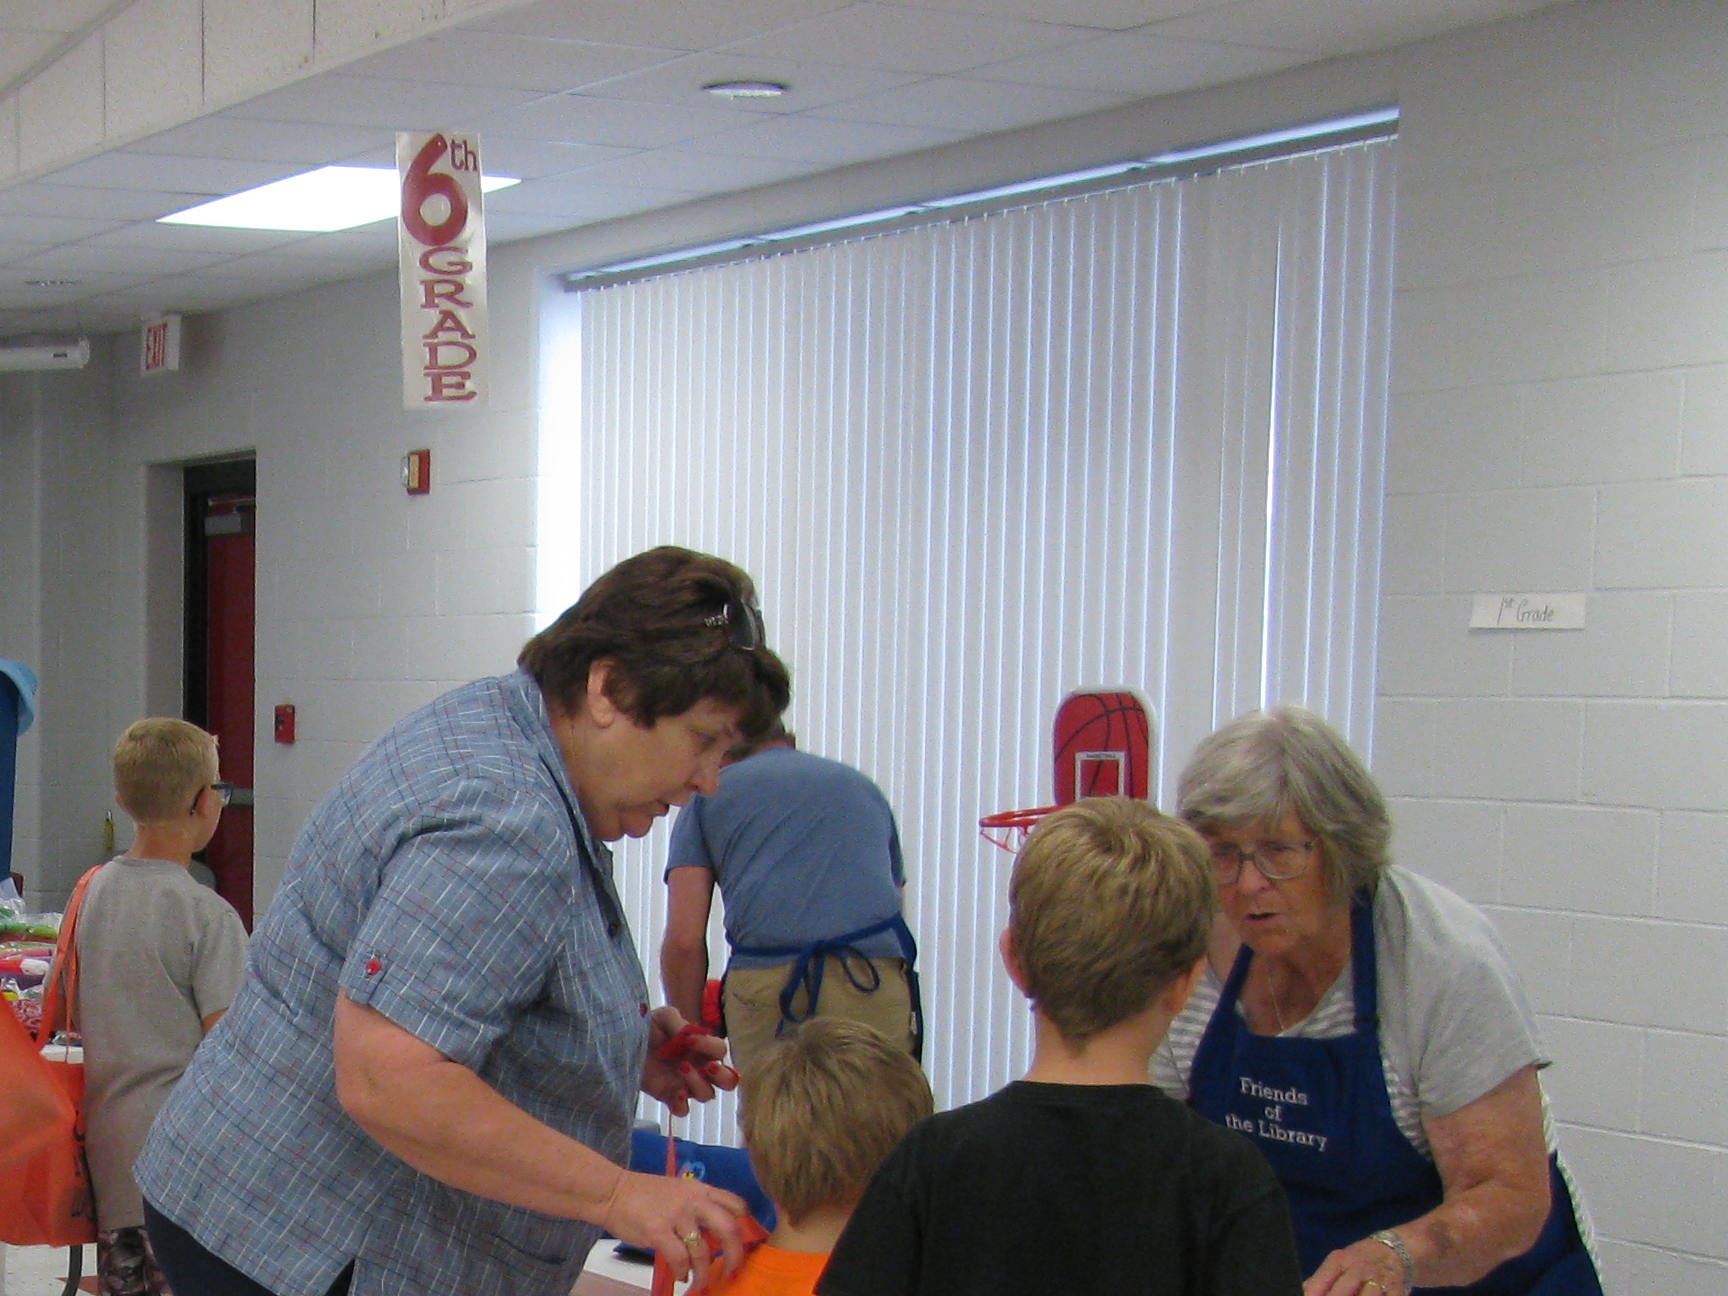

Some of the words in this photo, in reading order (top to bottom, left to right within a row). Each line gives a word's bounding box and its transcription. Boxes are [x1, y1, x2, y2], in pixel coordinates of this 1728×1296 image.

[402, 133, 478, 247] 6th
[419, 246, 478, 402] GRADE
[145, 322, 168, 370] EXIT
[1516, 599, 1554, 622] Grade
[1239, 1077, 1309, 1106] Friends
[1224, 1113, 1254, 1133] the
[1257, 1119, 1328, 1152] Library
[1264, 1105, 1282, 1122] of
